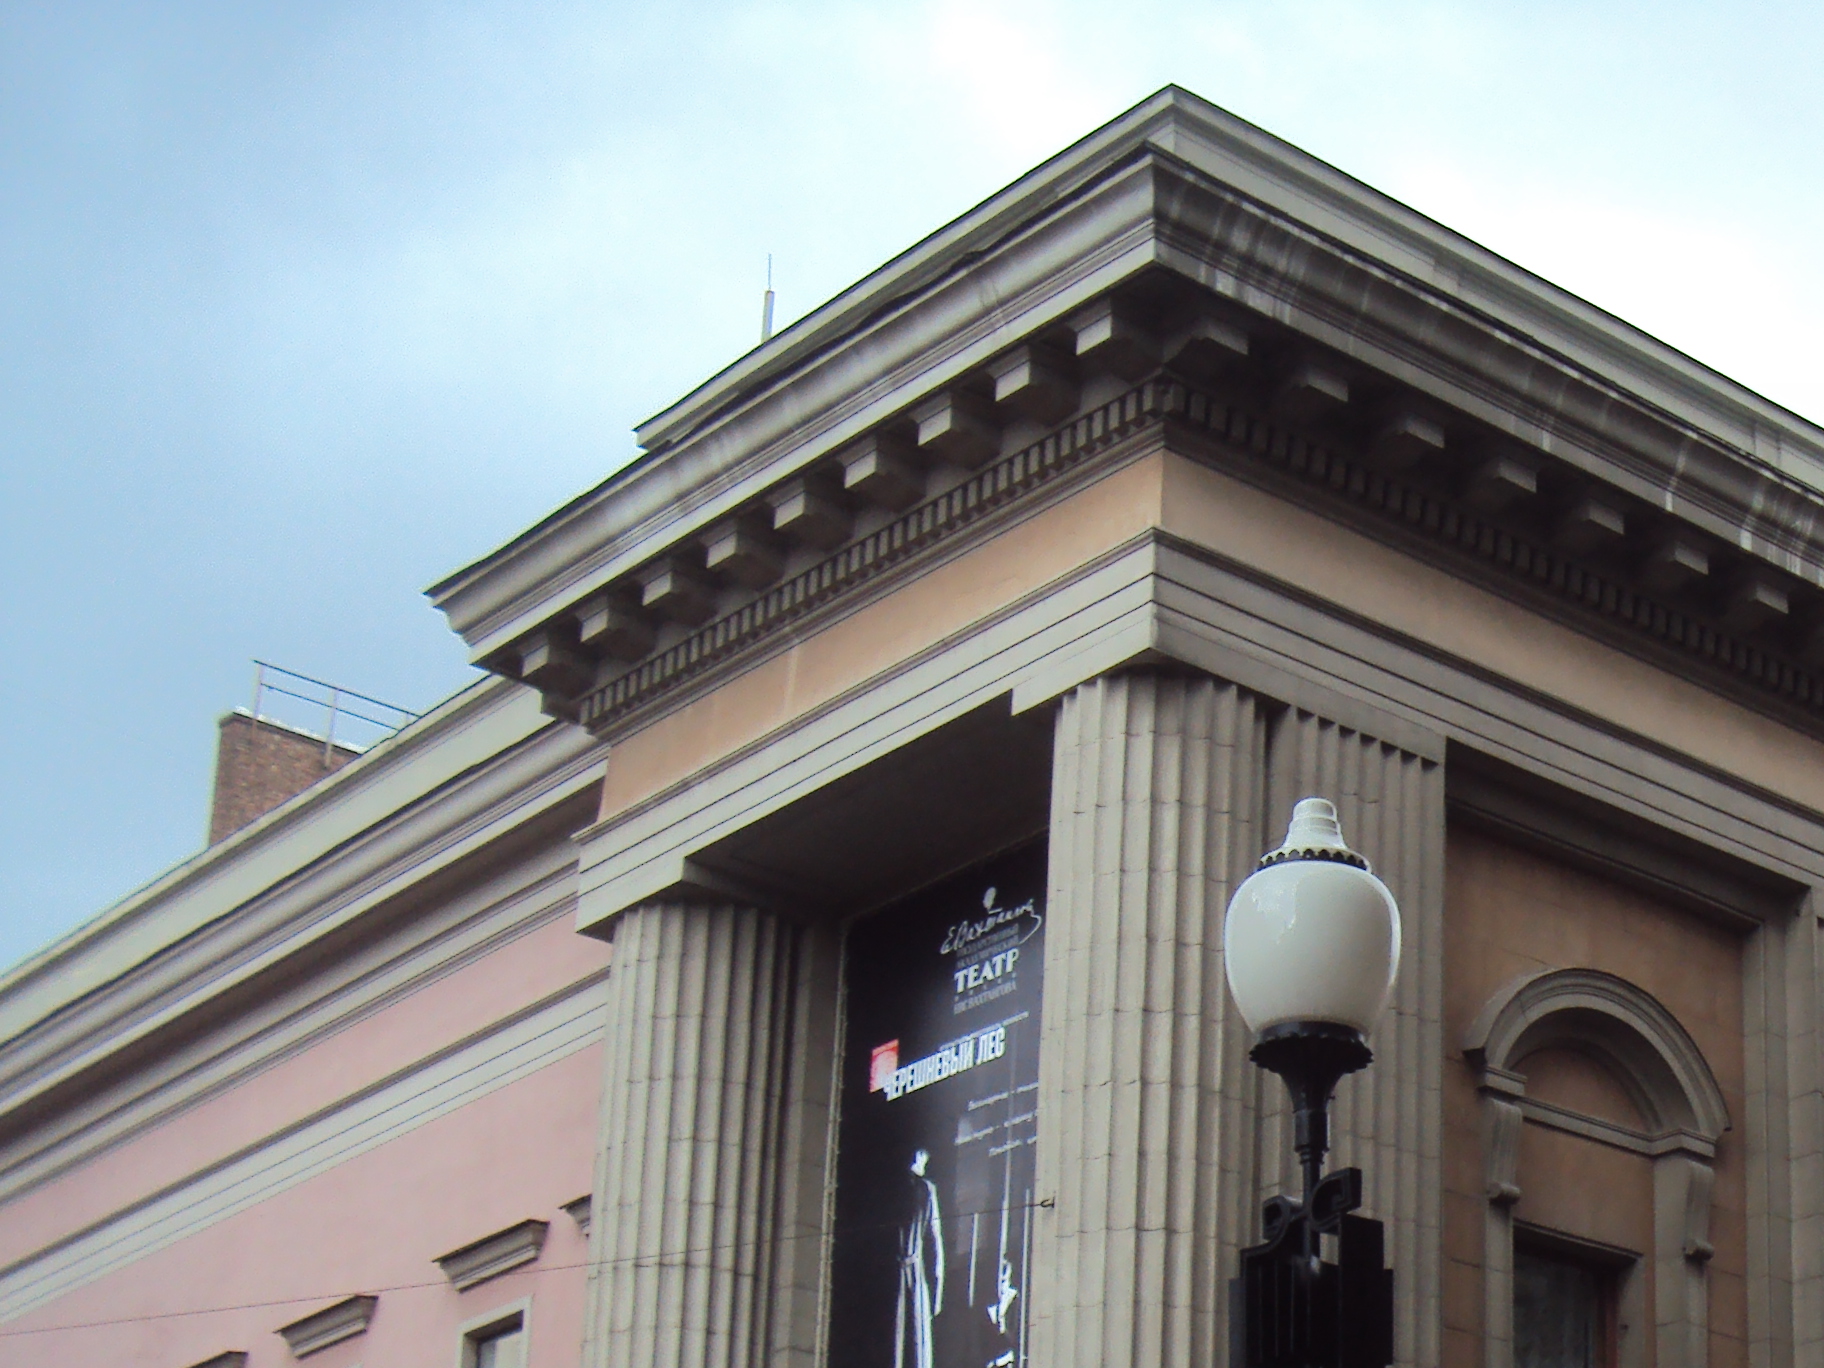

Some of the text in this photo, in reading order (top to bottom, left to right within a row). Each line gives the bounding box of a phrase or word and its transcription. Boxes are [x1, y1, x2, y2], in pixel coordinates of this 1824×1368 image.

[953, 948, 1020, 994] ТЕАТР
[883, 1038, 974, 1102] ЧЕРЕШНЕВЫЙ
[977, 1025, 1006, 1066] ЛЕС
